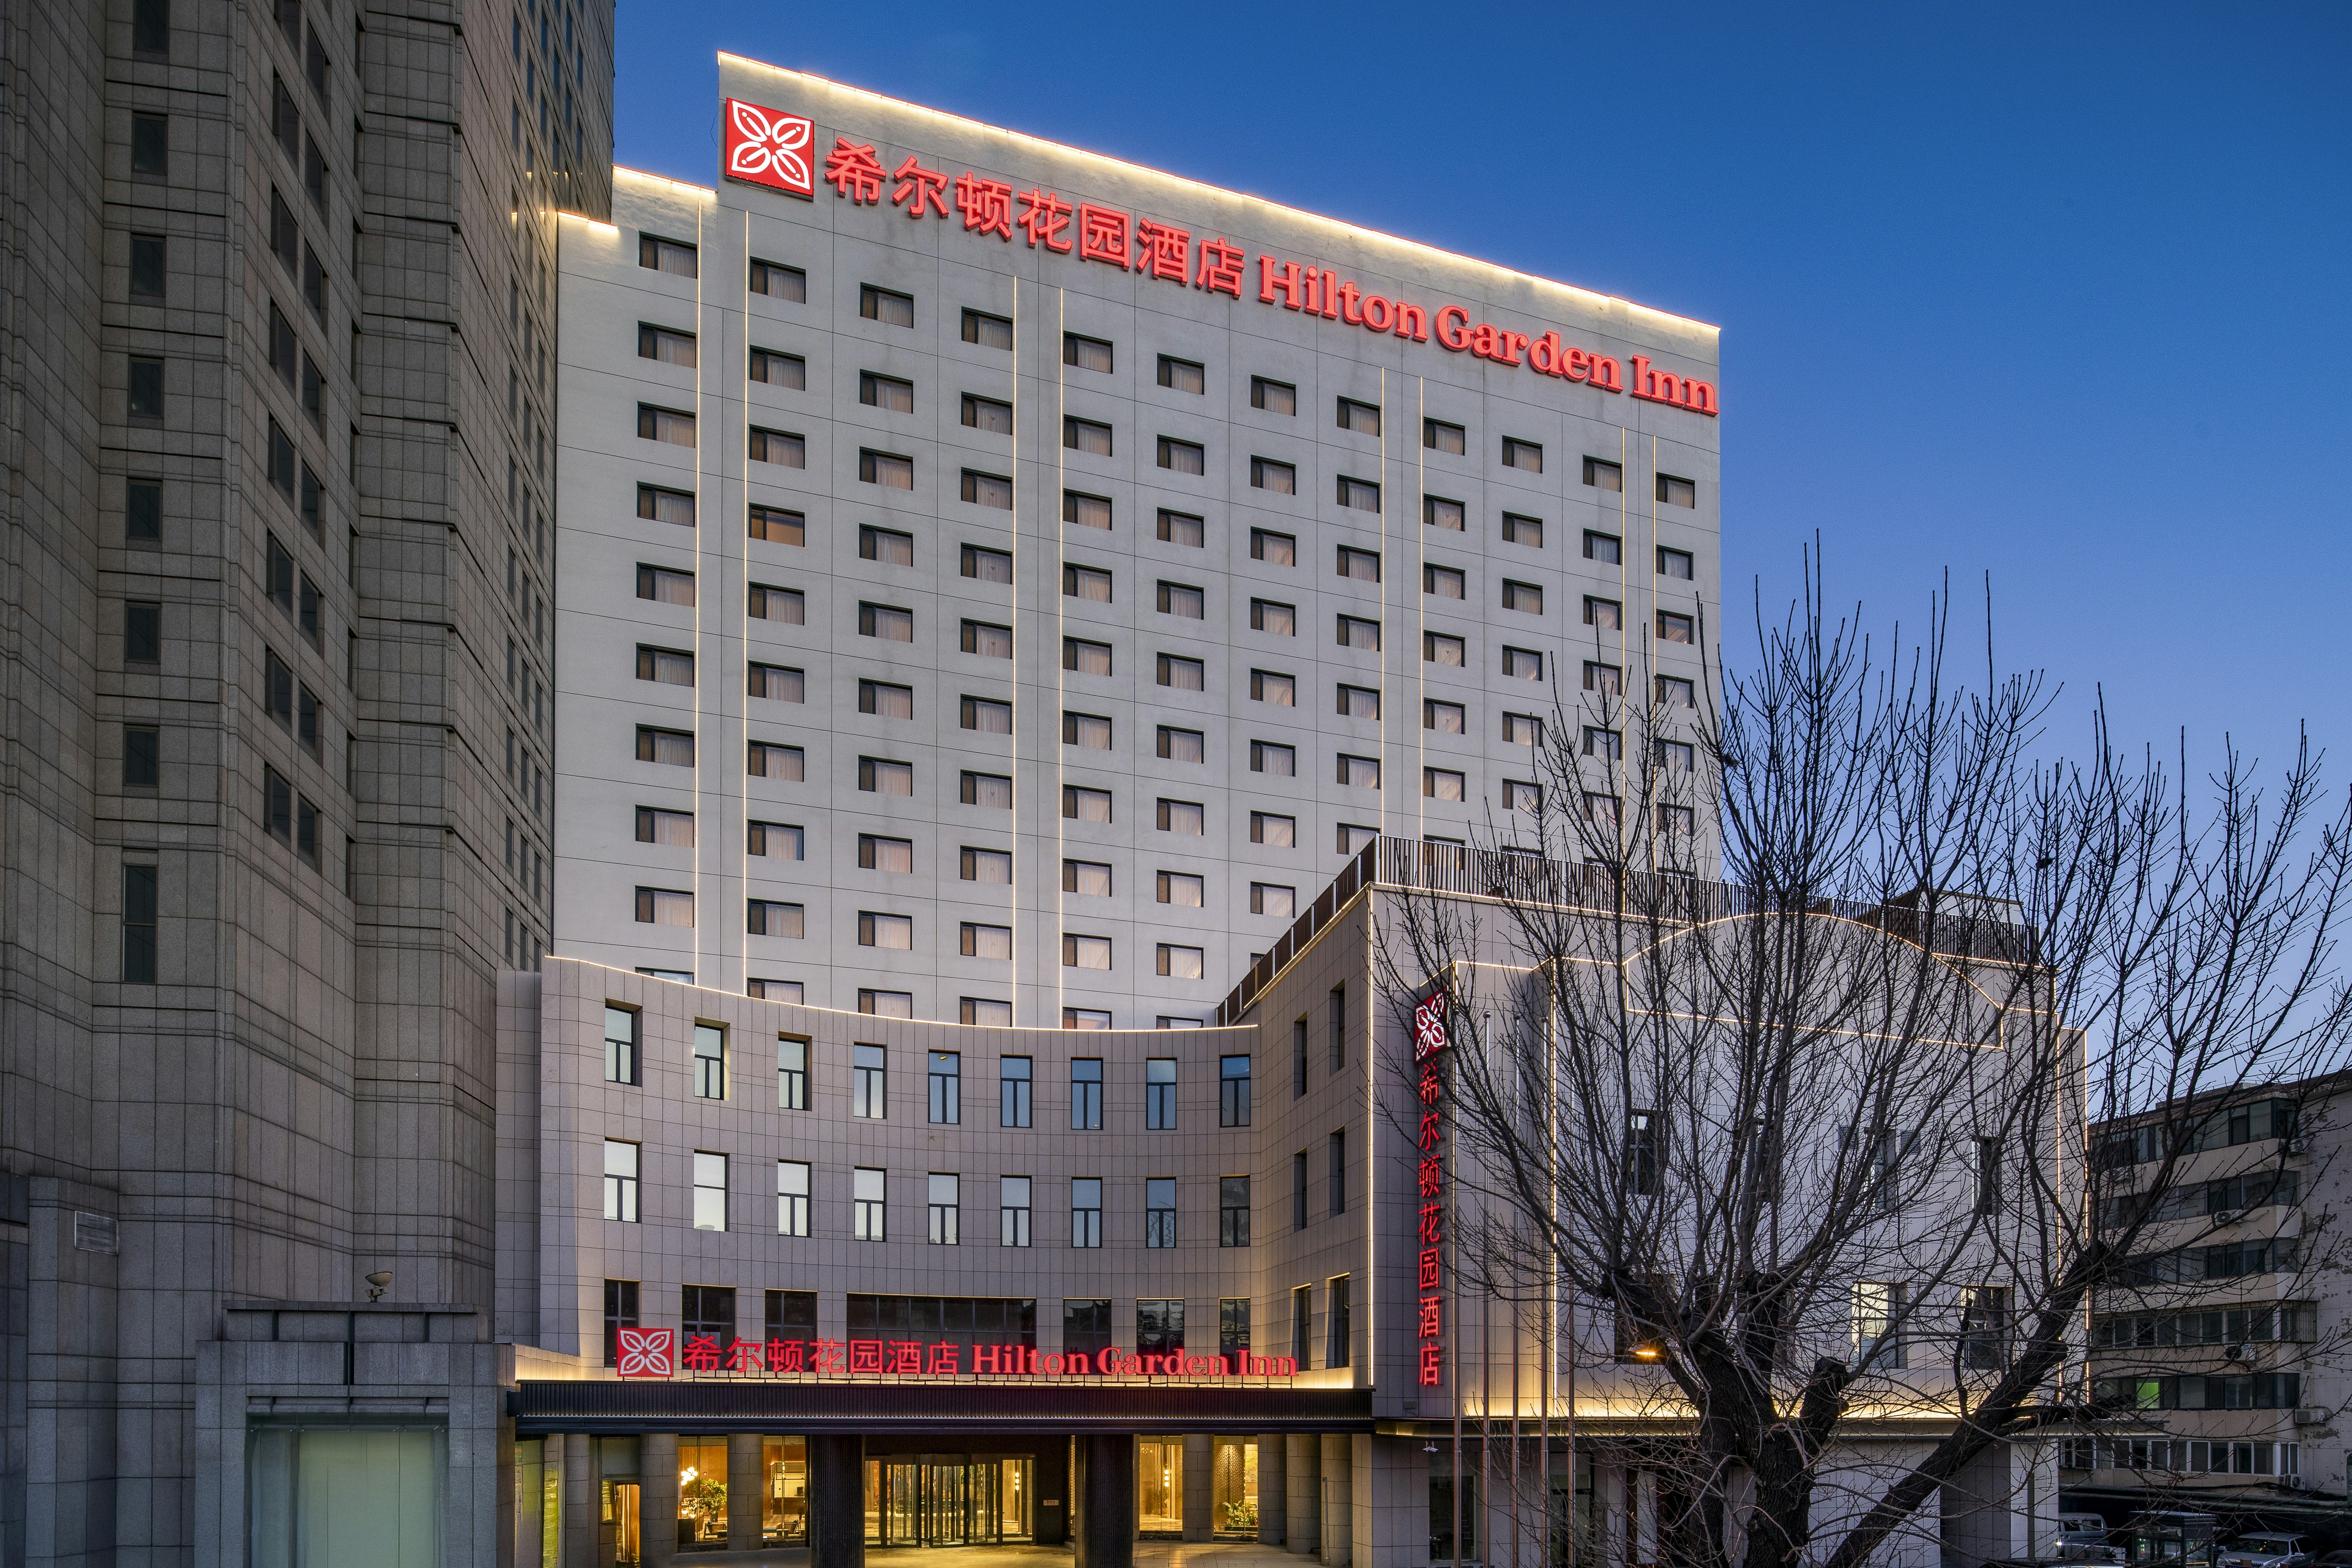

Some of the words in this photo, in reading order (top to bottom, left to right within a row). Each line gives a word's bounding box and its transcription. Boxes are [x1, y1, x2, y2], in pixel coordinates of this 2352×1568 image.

[824, 136, 1246, 299] 希尔顿花园酒店
[1259, 254, 1429, 341] Hilton
[1435, 305, 1625, 392] Garden
[1632, 354, 1720, 416] Inn
[1418, 1057, 1441, 1387] 希尔顿花园酒店
[682, 1335, 960, 1377] 希尔顿花园酒店
[972, 1344, 1090, 1376] Hilton
[1097, 1346, 1230, 1376] Garden
[1237, 1348, 1299, 1377] Inn
